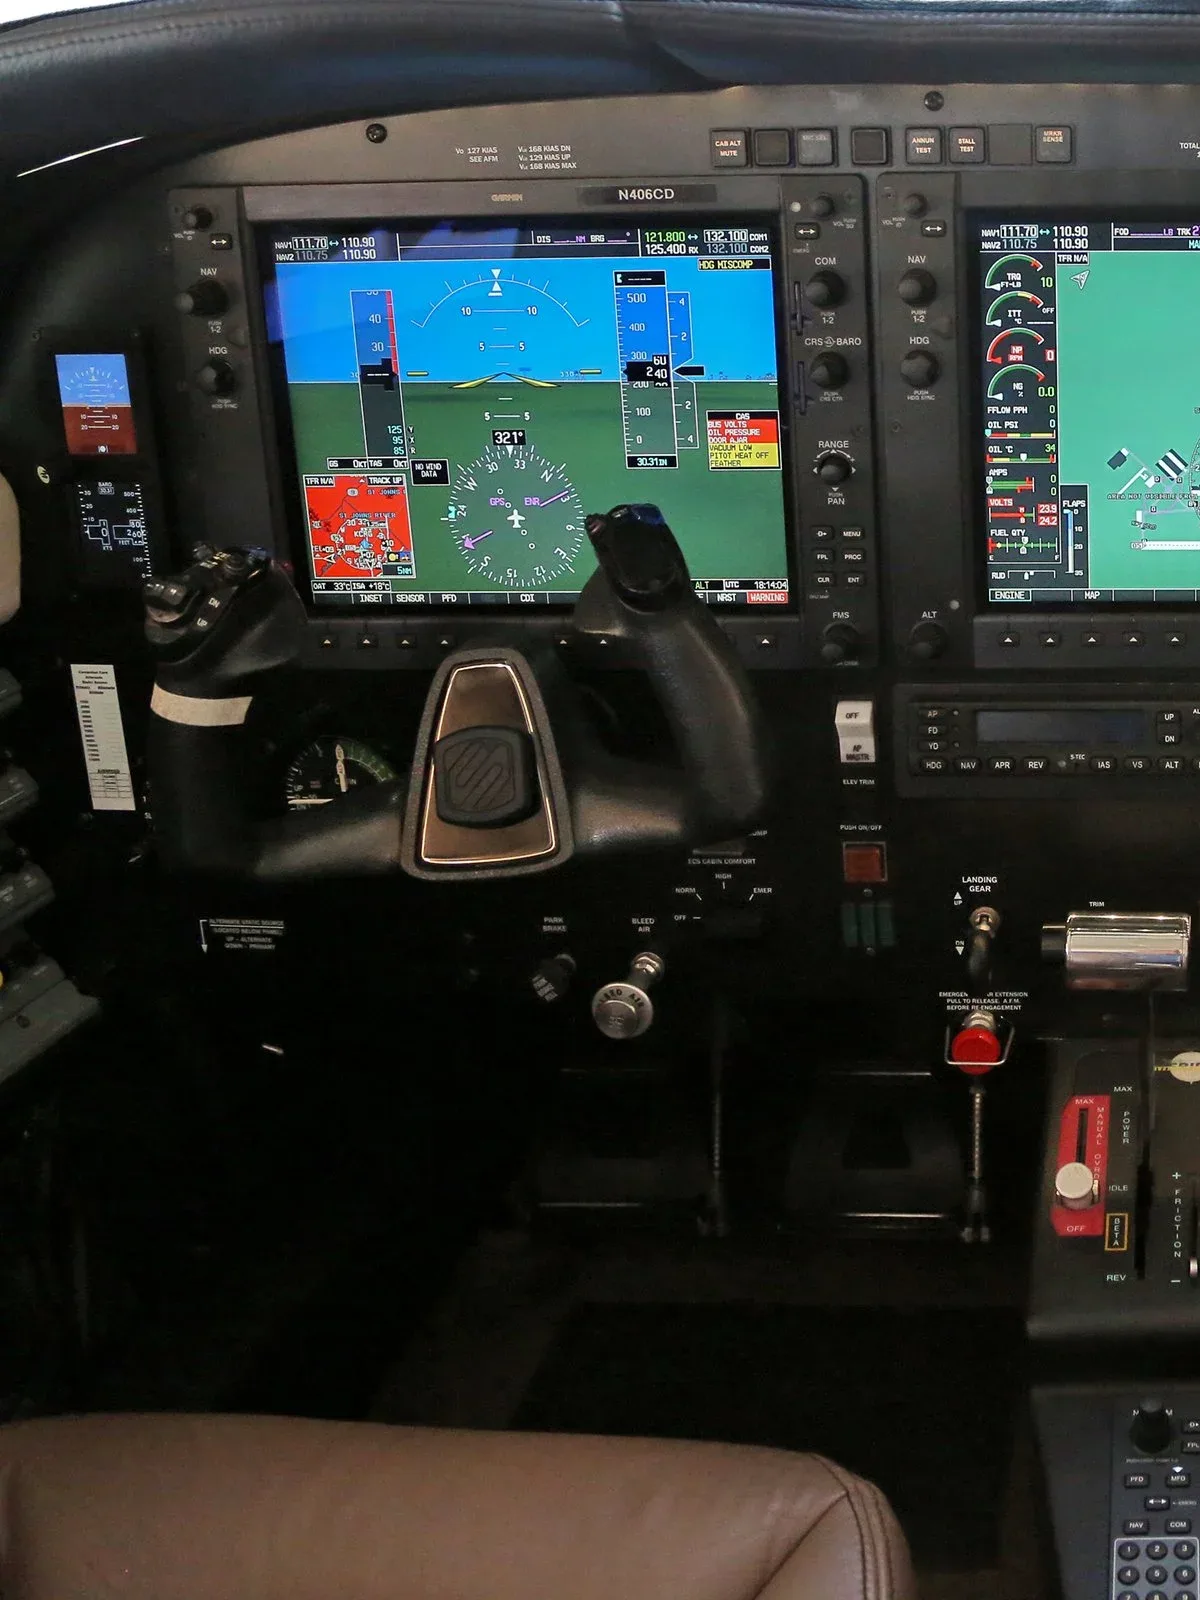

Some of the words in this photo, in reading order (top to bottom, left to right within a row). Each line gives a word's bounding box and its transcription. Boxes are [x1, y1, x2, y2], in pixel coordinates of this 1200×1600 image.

[715, 140, 727, 148] CAB
[912, 137, 934, 145] ANNUN
[482, 146, 497, 154] KIAS
[529, 145, 541, 153] 168
[561, 144, 570, 152] DN
[960, 145, 974, 153] TEST
[1180, 142, 1199, 150] TOTAL
[470, 155, 482, 163] SEE
[484, 155, 498, 163] AFM
[544, 153, 560, 161] KIAS
[561, 153, 570, 161] UP
[530, 162, 543, 170] 168
[544, 162, 560, 170] KIAS
[619, 189, 674, 200] N406CD
[645, 232, 685, 242] 121.800
[705, 231, 746, 242] 132.100
[750, 233, 768, 241] COM1
[275, 241, 292, 249] NAV1
[294, 238, 327, 249] 111.70
[342, 237, 375, 248] 110.90
[645, 244, 686, 254] 125.400
[707, 243, 747, 253] 132.100
[750, 245, 768, 253] COM2
[276, 253, 294, 261] NAV2
[296, 251, 328, 260] 110.75
[343, 249, 376, 260] 110.90
[815, 257, 836, 265] COM
[908, 256, 926, 264] NAV
[699, 260, 715, 269] HDG
[719, 260, 753, 269] MISCOMP
[988, 406, 1010, 414] FFLOW
[708, 420, 721, 428] BUS
[724, 420, 747, 428] VOLTS
[709, 428, 722, 436] OIL
[725, 428, 760, 436] PRESSURE
[495, 432, 523, 444] 321°
[709, 436, 727, 444] DOOR
[730, 436, 748, 444] AJAR
[709, 444, 736, 452] VACUUM
[710, 452, 731, 460] PITOT
[756, 451, 769, 459] OFF
[710, 459, 741, 467] FEATHER
[1063, 500, 1085, 508] FLAPS
[1040, 505, 1056, 513] 23.9
[843, 530, 860, 538] MENU
[754, 581, 787, 589] 18:14:04
[846, 712, 859, 720] OFF
[1165, 735, 1174, 743] DN
[962, 876, 997, 884] LANDING
[970, 885, 991, 893] GEAR
[632, 917, 654, 925] BLEED
[638, 925, 650, 933] AIR
[1114, 1085, 1132, 1093] MAX
[1109, 1184, 1128, 1192] IDLE
[1067, 1225, 1085, 1233] OFF
[1106, 1274, 1126, 1282] REV
[1130, 1475, 1143, 1483] PFD
